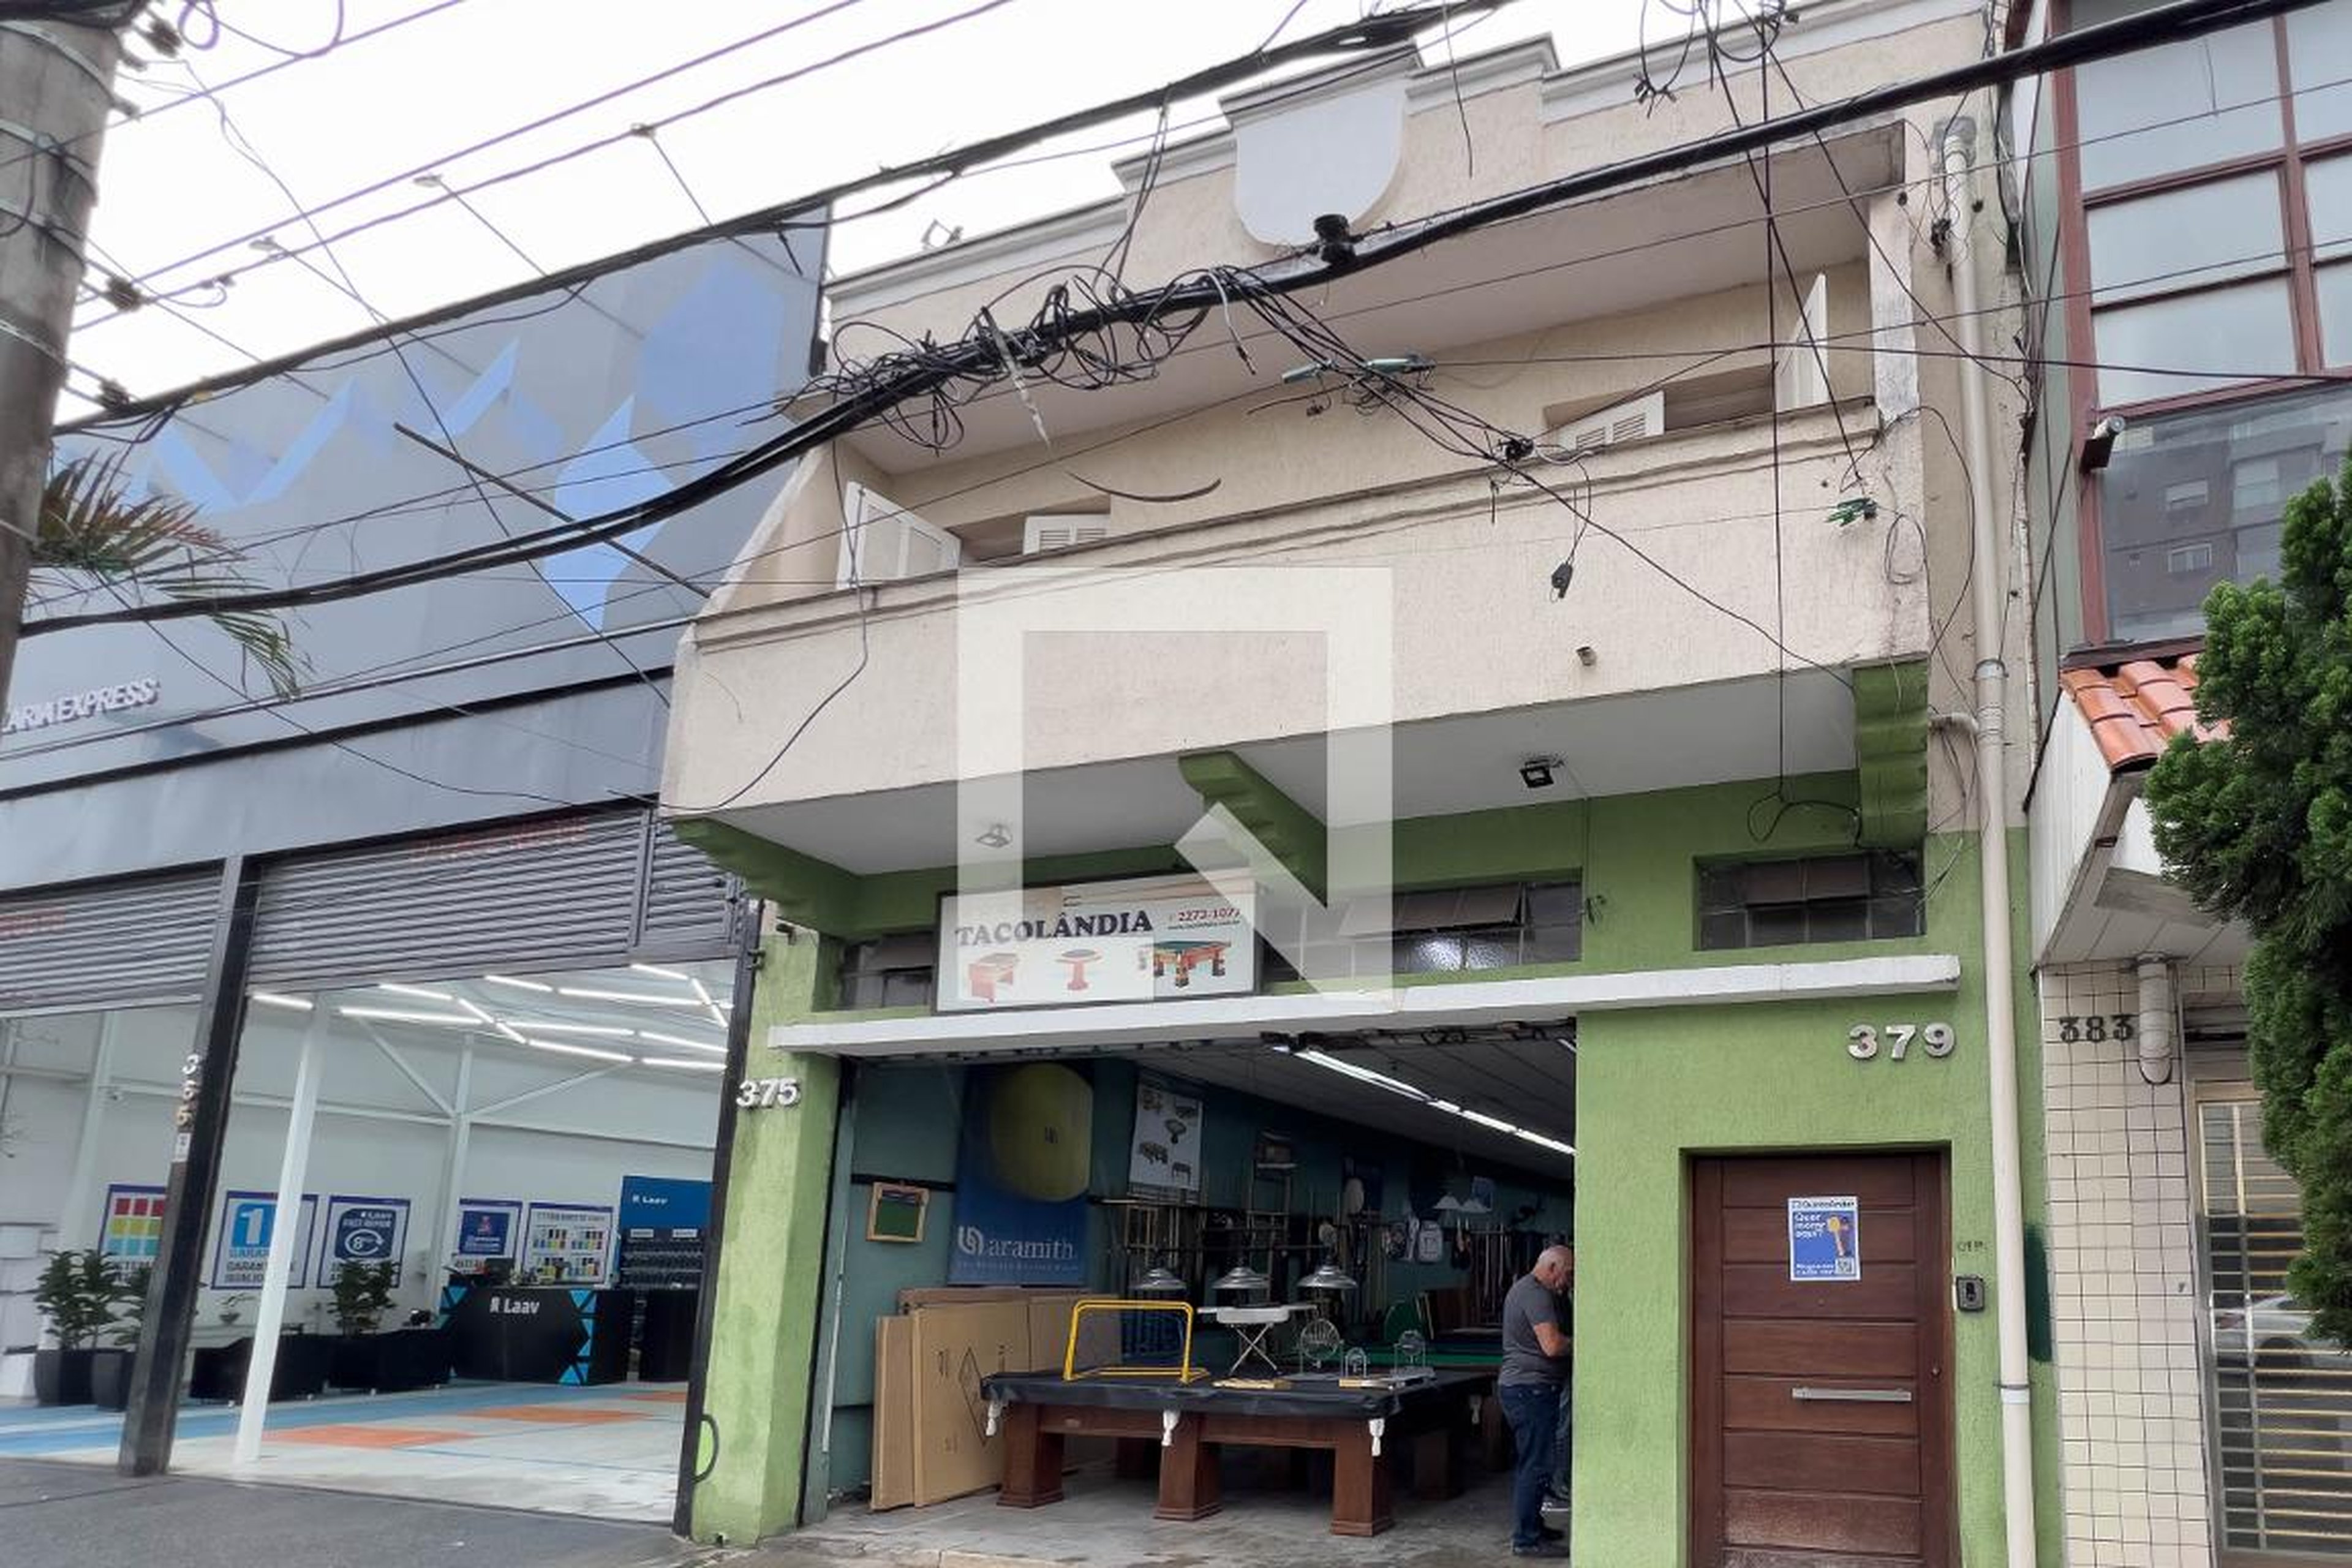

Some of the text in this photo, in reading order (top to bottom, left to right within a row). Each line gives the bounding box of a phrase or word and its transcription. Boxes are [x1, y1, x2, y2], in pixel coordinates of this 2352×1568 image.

[59, 678, 160, 721] EXPRESS
[956, 911, 1152, 945] TACOLÂNDIA
[1848, 1022, 1956, 1060] 379
[2059, 1014, 2133, 1042] 383
[736, 1077, 801, 1107] 375
[989, 1238, 1073, 1259] aramith
[504, 1298, 539, 1314] Laav
